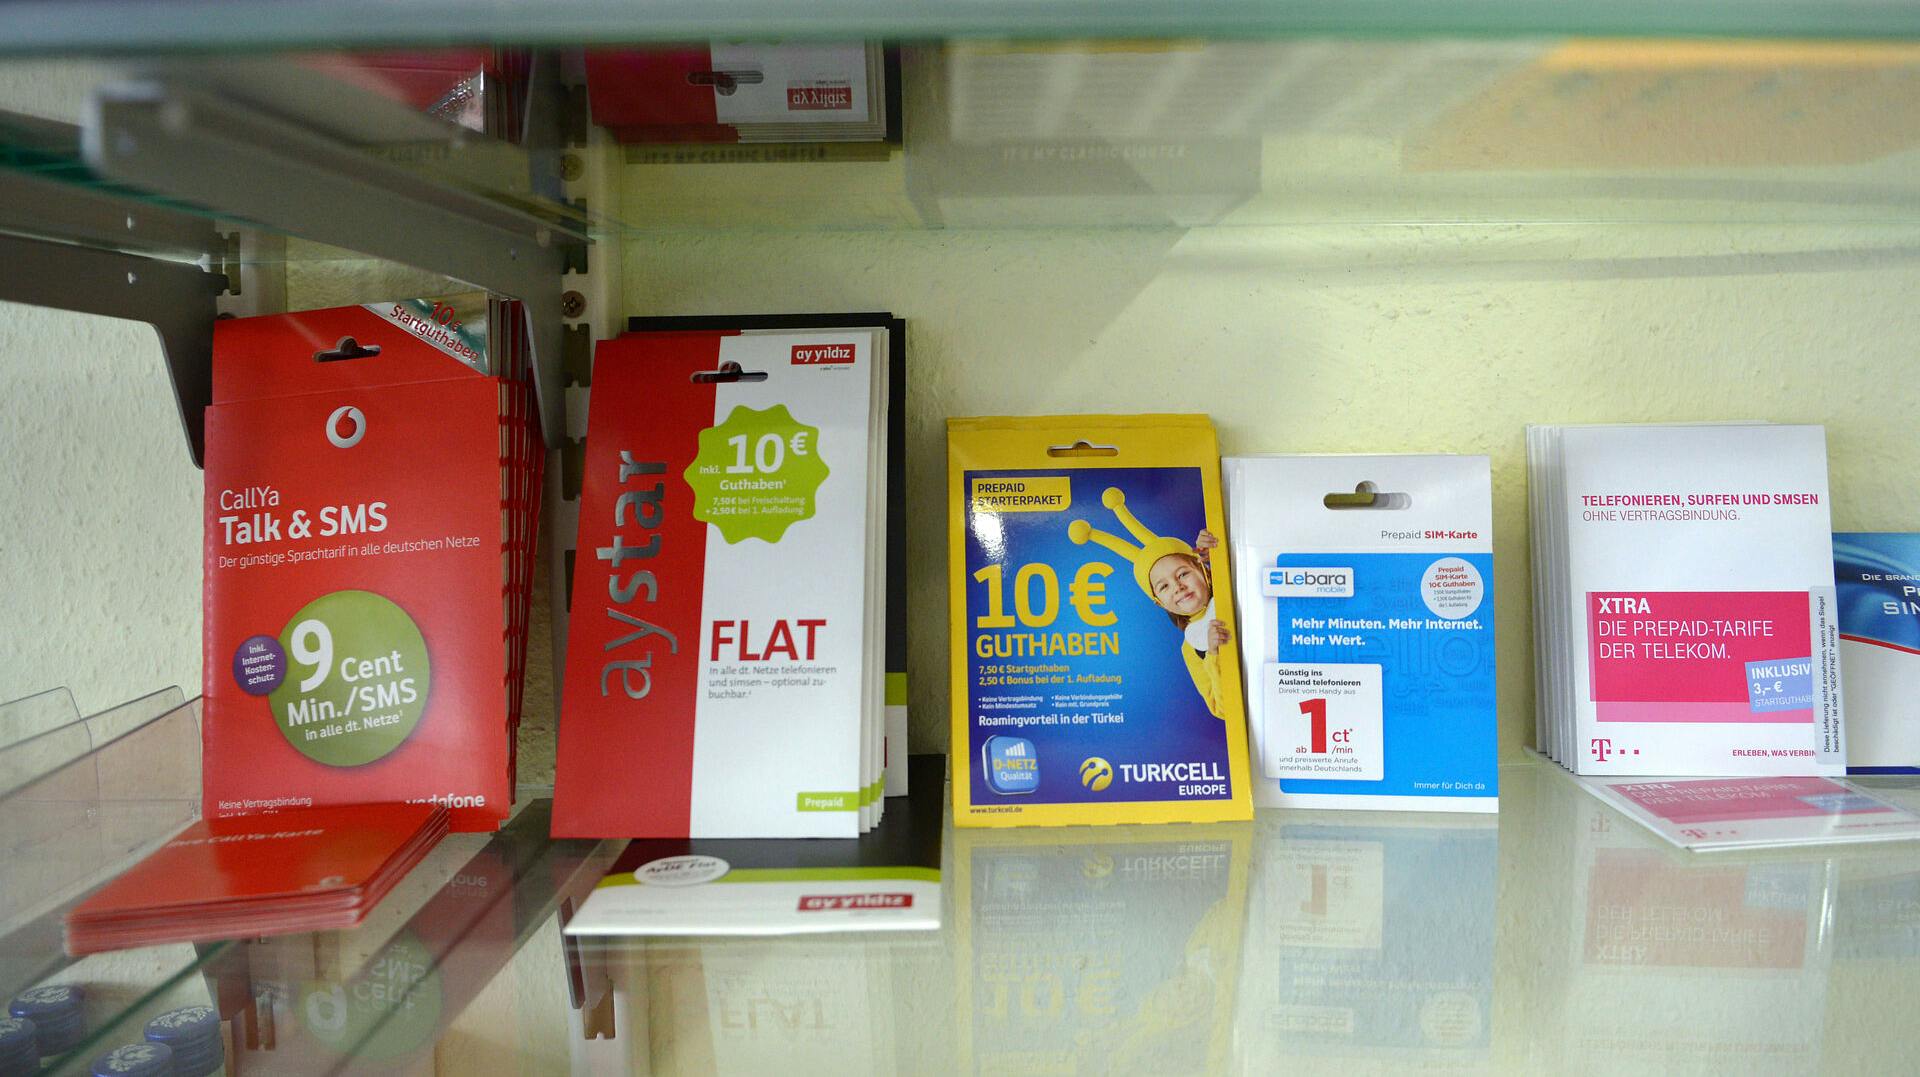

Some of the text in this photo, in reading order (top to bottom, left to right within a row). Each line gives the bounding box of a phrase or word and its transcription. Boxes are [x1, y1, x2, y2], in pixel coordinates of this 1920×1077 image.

[390, 304, 479, 361] Startguthaben
[700, 464, 720, 474] Inkl.
[726, 433, 784, 474] 10
[977, 482, 1026, 493] PREPAID
[220, 486, 280, 512] CallYa
[738, 496, 805, 506] bei Freischaltung
[977, 495, 1062, 506] STARTERPAKET
[1582, 493, 1818, 508] TELEFONIEREN, SURFEN UND SMSEN
[738, 507, 750, 515] bei
[761, 506, 805, 516] Aufladung
[1583, 509, 1740, 522] OHNE VERTRAGSBINDUNG.
[219, 502, 388, 546] Talk & SMS
[1381, 530, 1478, 542] Prepaid SIM-Karte
[219, 536, 480, 570] Der günstige Sprachtarif in alle deutschen Netze
[596, 451, 678, 700] aystar
[1438, 565, 1464, 573] Prepaid
[1285, 571, 1346, 586] Lebara
[973, 561, 1118, 628] 10 €
[1317, 586, 1346, 594] mobile
[1599, 597, 1651, 614] XTRA
[1817, 596, 1826, 617] Siegel
[1292, 618, 1483, 630] Mehr Minuten. Mehr Internet.
[1600, 620, 1773, 637] DIE PREPAID-TARIFE
[1818, 617, 1826, 629] das
[710, 619, 827, 661] FLAT
[1292, 634, 1366, 646] Mehr Wert.
[1819, 630, 1827, 648] wenn
[1828, 624, 1836, 647] anzeigt
[975, 632, 1120, 659] GUTHABEN
[1600, 643, 1731, 659] DER TELEKOM.
[242, 653, 276, 666] Internet-
[291, 619, 404, 693] 9 Cent
[245, 664, 276, 675] Kosten-
[709, 667, 718, 675] In
[721, 666, 736, 675] alle
[752, 666, 779, 675] Netze
[781, 664, 837, 675] telefonieren
[979, 665, 997, 674] 7,50
[1006, 664, 1070, 675] Startguthaben
[1278, 669, 1309, 678] Günstig
[248, 674, 275, 685] schutz
[709, 677, 827, 692] und simsen optional zu-
[979, 677, 998, 686] 2,50
[1006, 676, 1034, 685] Bonus
[1035, 675, 1049, 684] bei
[1051, 675, 1064, 684] der
[1077, 674, 1122, 685] Aufladung
[1313, 679, 1361, 687] telefonieren
[1821, 686, 1829, 702] nicht
[1830, 693, 1838, 708] oder
[287, 678, 417, 727] Min./SMS
[1755, 695, 1813, 707] STARTGUTHAB
[978, 712, 1124, 728] Roamingvorteil in der Türkei
[1822, 703, 1831, 734] Lieferung
[305, 720, 361, 741] in alle dt.
[1299, 698, 1327, 754] 1
[1830, 717, 1840, 753] beschädigt
[1296, 745, 1307, 754] ab
[1331, 745, 1353, 755] /min
[1732, 749, 1770, 758] ERLEBEN,
[1771, 749, 1788, 757] WAS
[993, 758, 1037, 771] D-NETZ
[1295, 757, 1332, 765] preiswerte
[1000, 771, 1033, 782] Qualität
[1120, 762, 1225, 783] TURKCELL
[1179, 785, 1226, 796] EUROPE
[1414, 781, 1486, 790] Immer für Dich da
[219, 797, 312, 809] Keine Vertragsbindung
[804, 797, 843, 809] Prepaid
[970, 805, 1022, 814] www.turkcell.de
